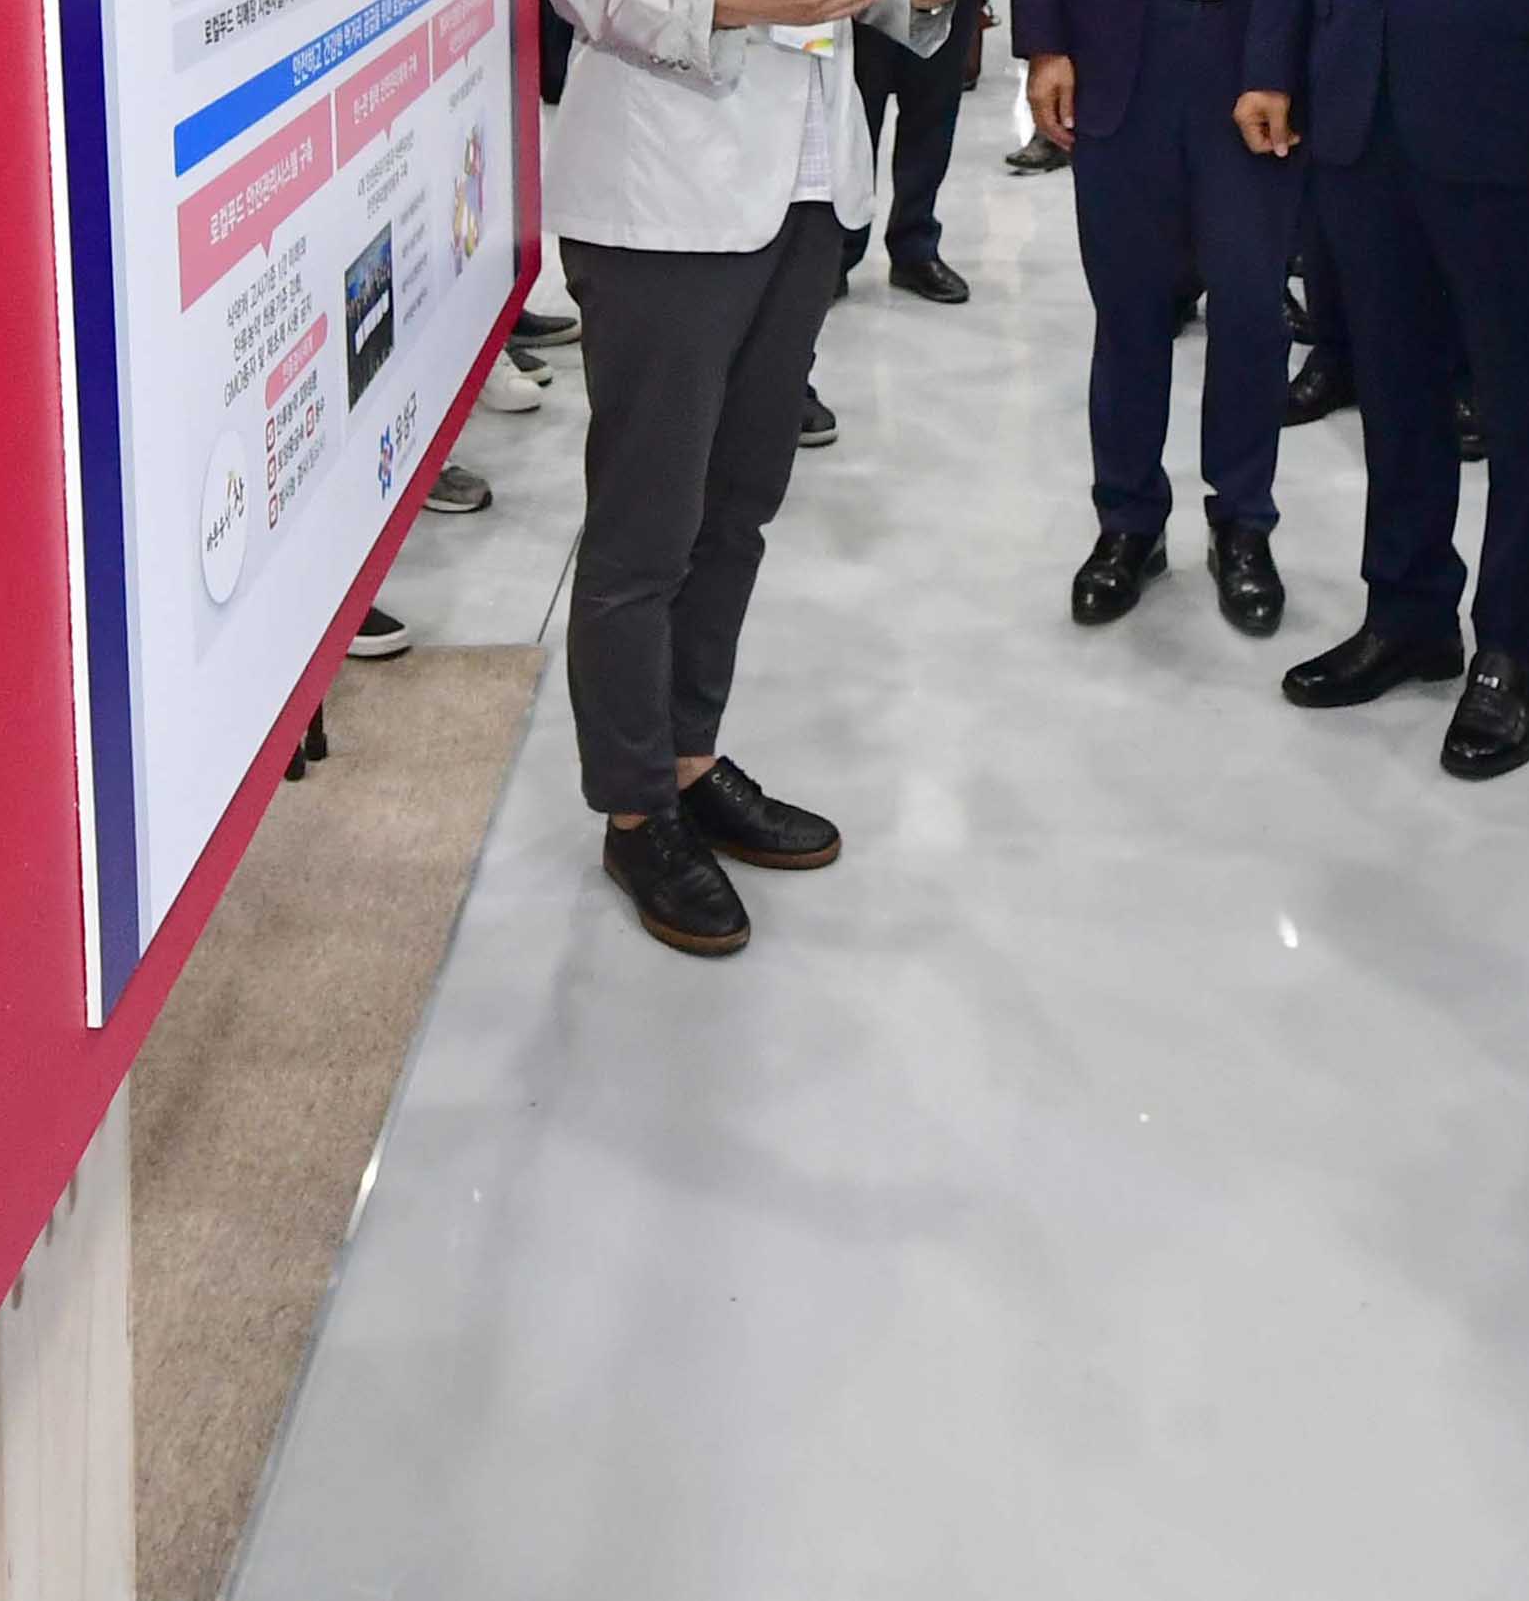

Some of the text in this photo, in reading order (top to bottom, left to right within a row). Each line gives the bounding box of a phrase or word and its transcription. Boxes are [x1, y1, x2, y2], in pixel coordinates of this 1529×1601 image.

[203, 6, 233, 47] 로컬푸드
[292, 40, 321, 88] 안전하고
[323, 26, 342, 66] 건강한
[209, 190, 244, 249] 로컬푸드
[246, 147, 298, 219] 안전관리시스템
